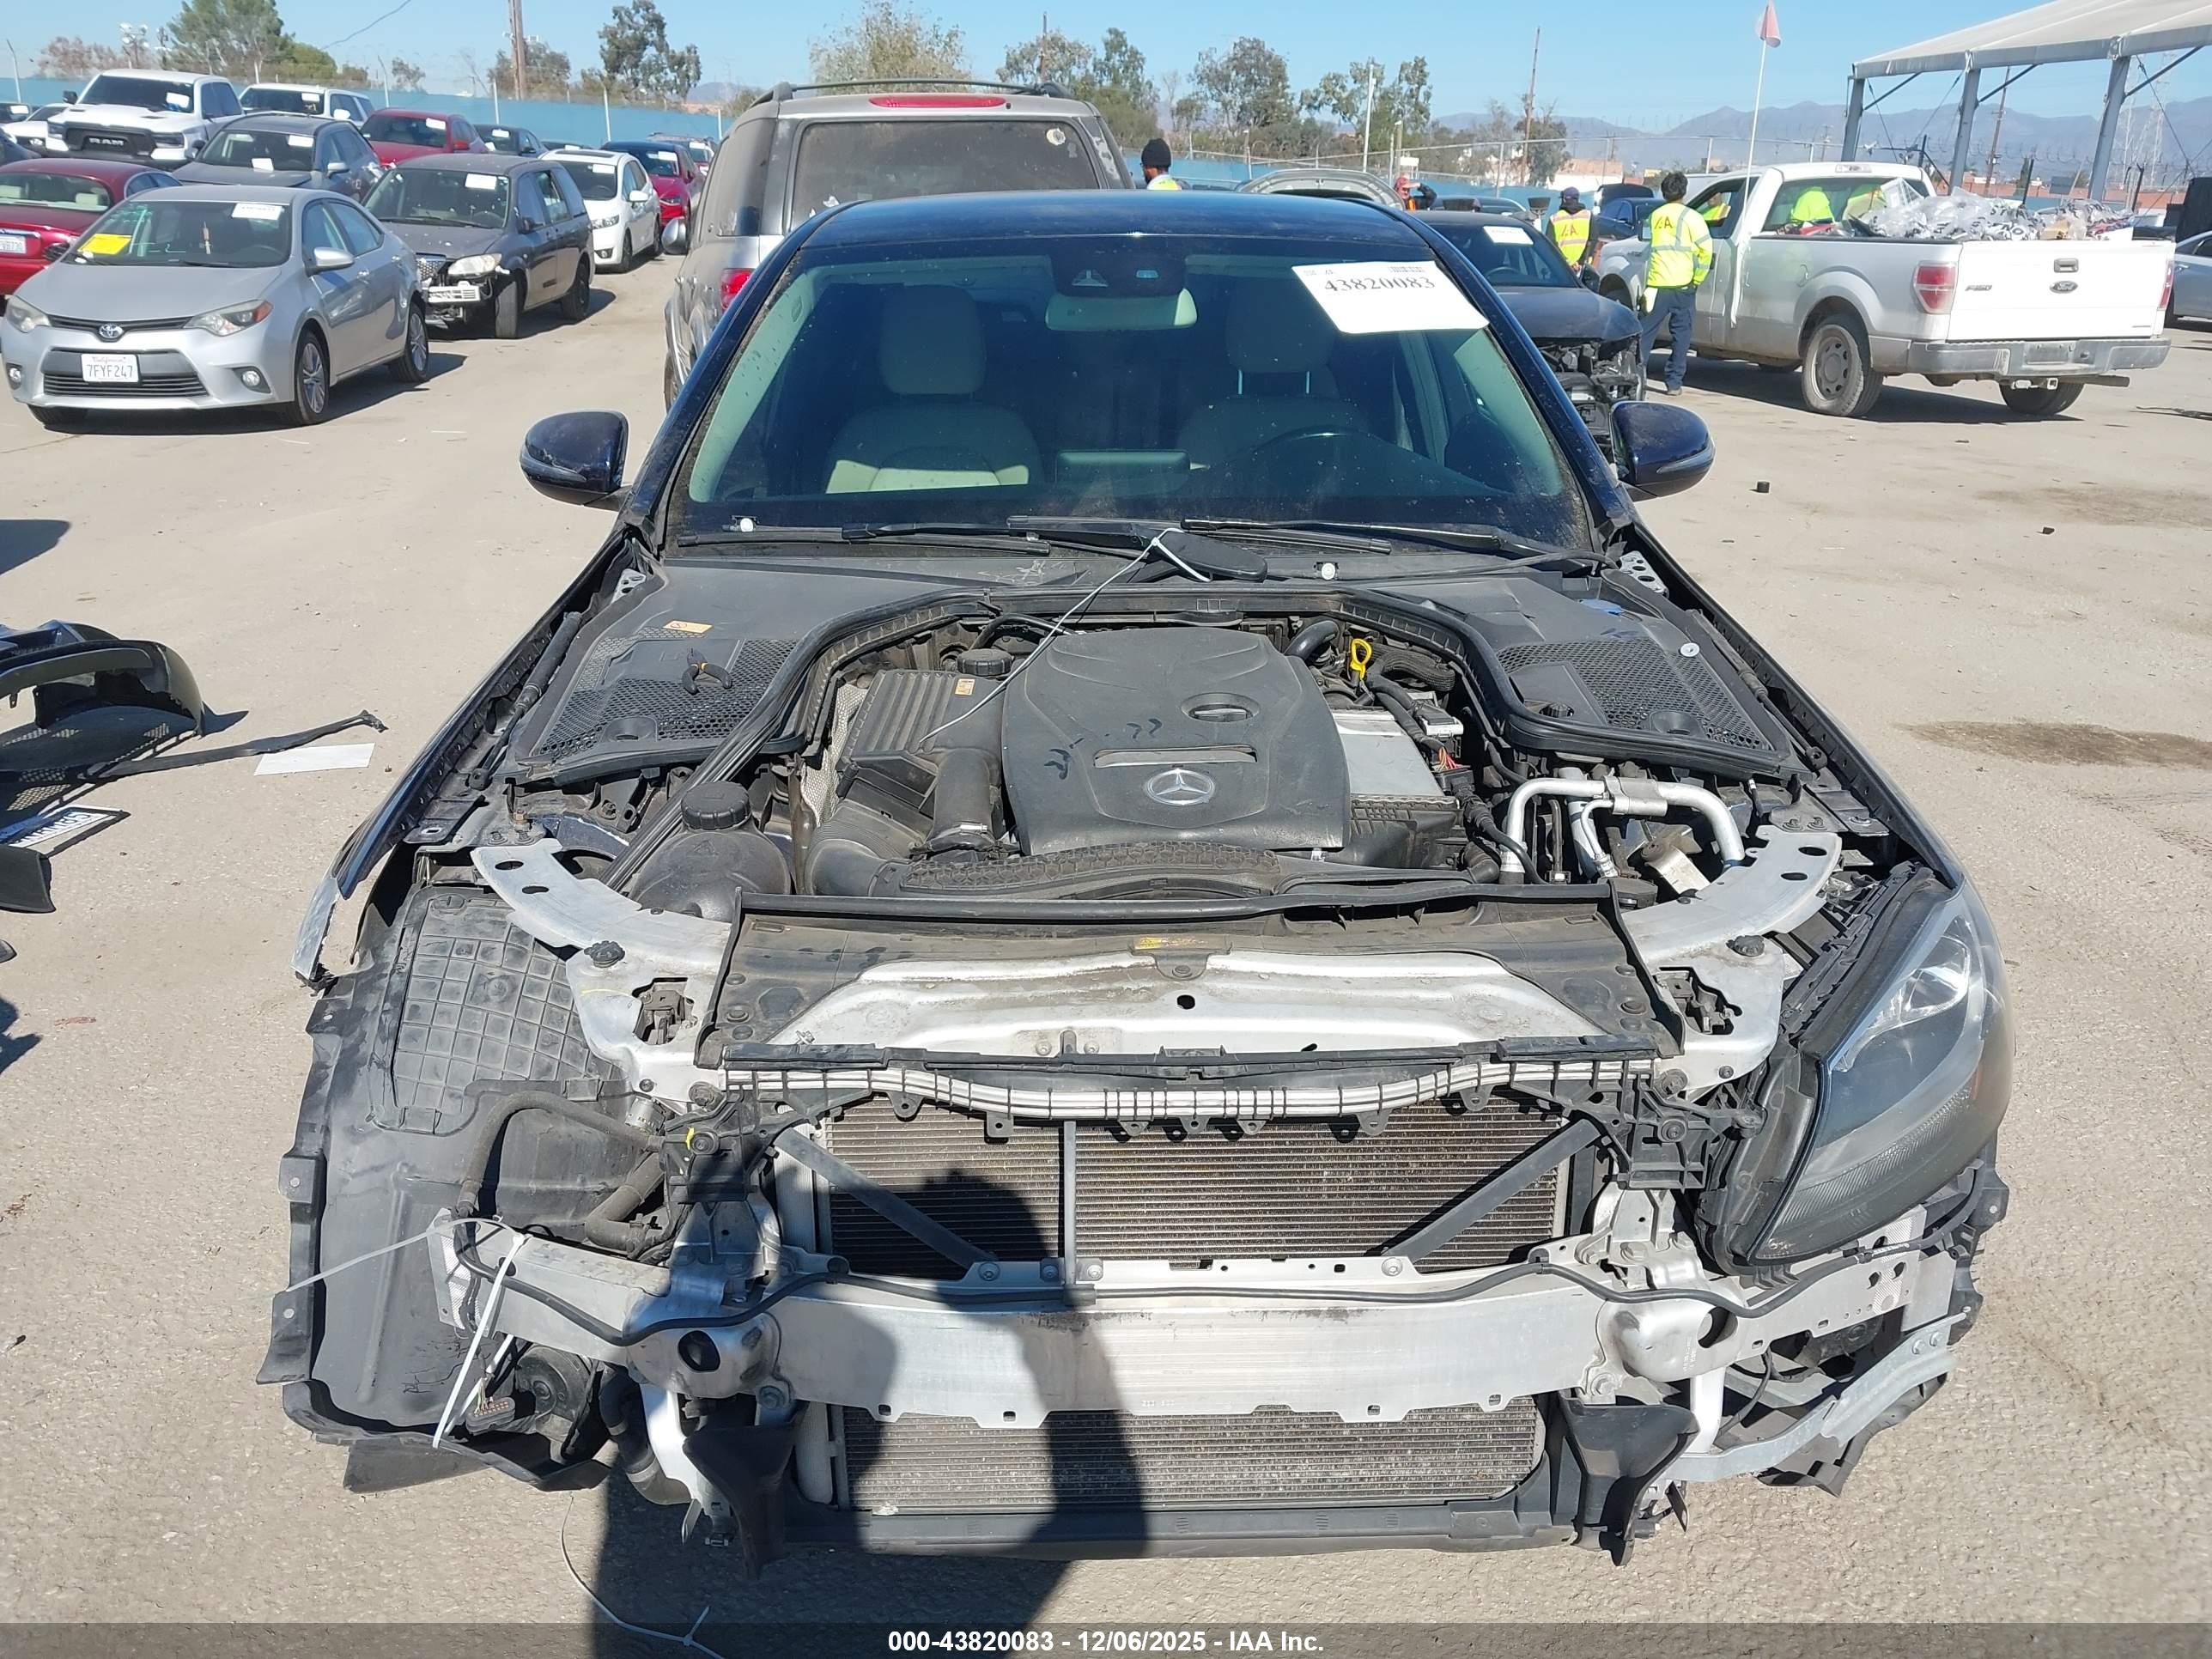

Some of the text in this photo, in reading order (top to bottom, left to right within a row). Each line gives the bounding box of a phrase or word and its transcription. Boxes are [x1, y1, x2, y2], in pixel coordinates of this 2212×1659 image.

[88, 137, 125, 146] RAM
[1324, 276, 1436, 292] 43820083
[87, 364, 132, 378] 7FYF247
